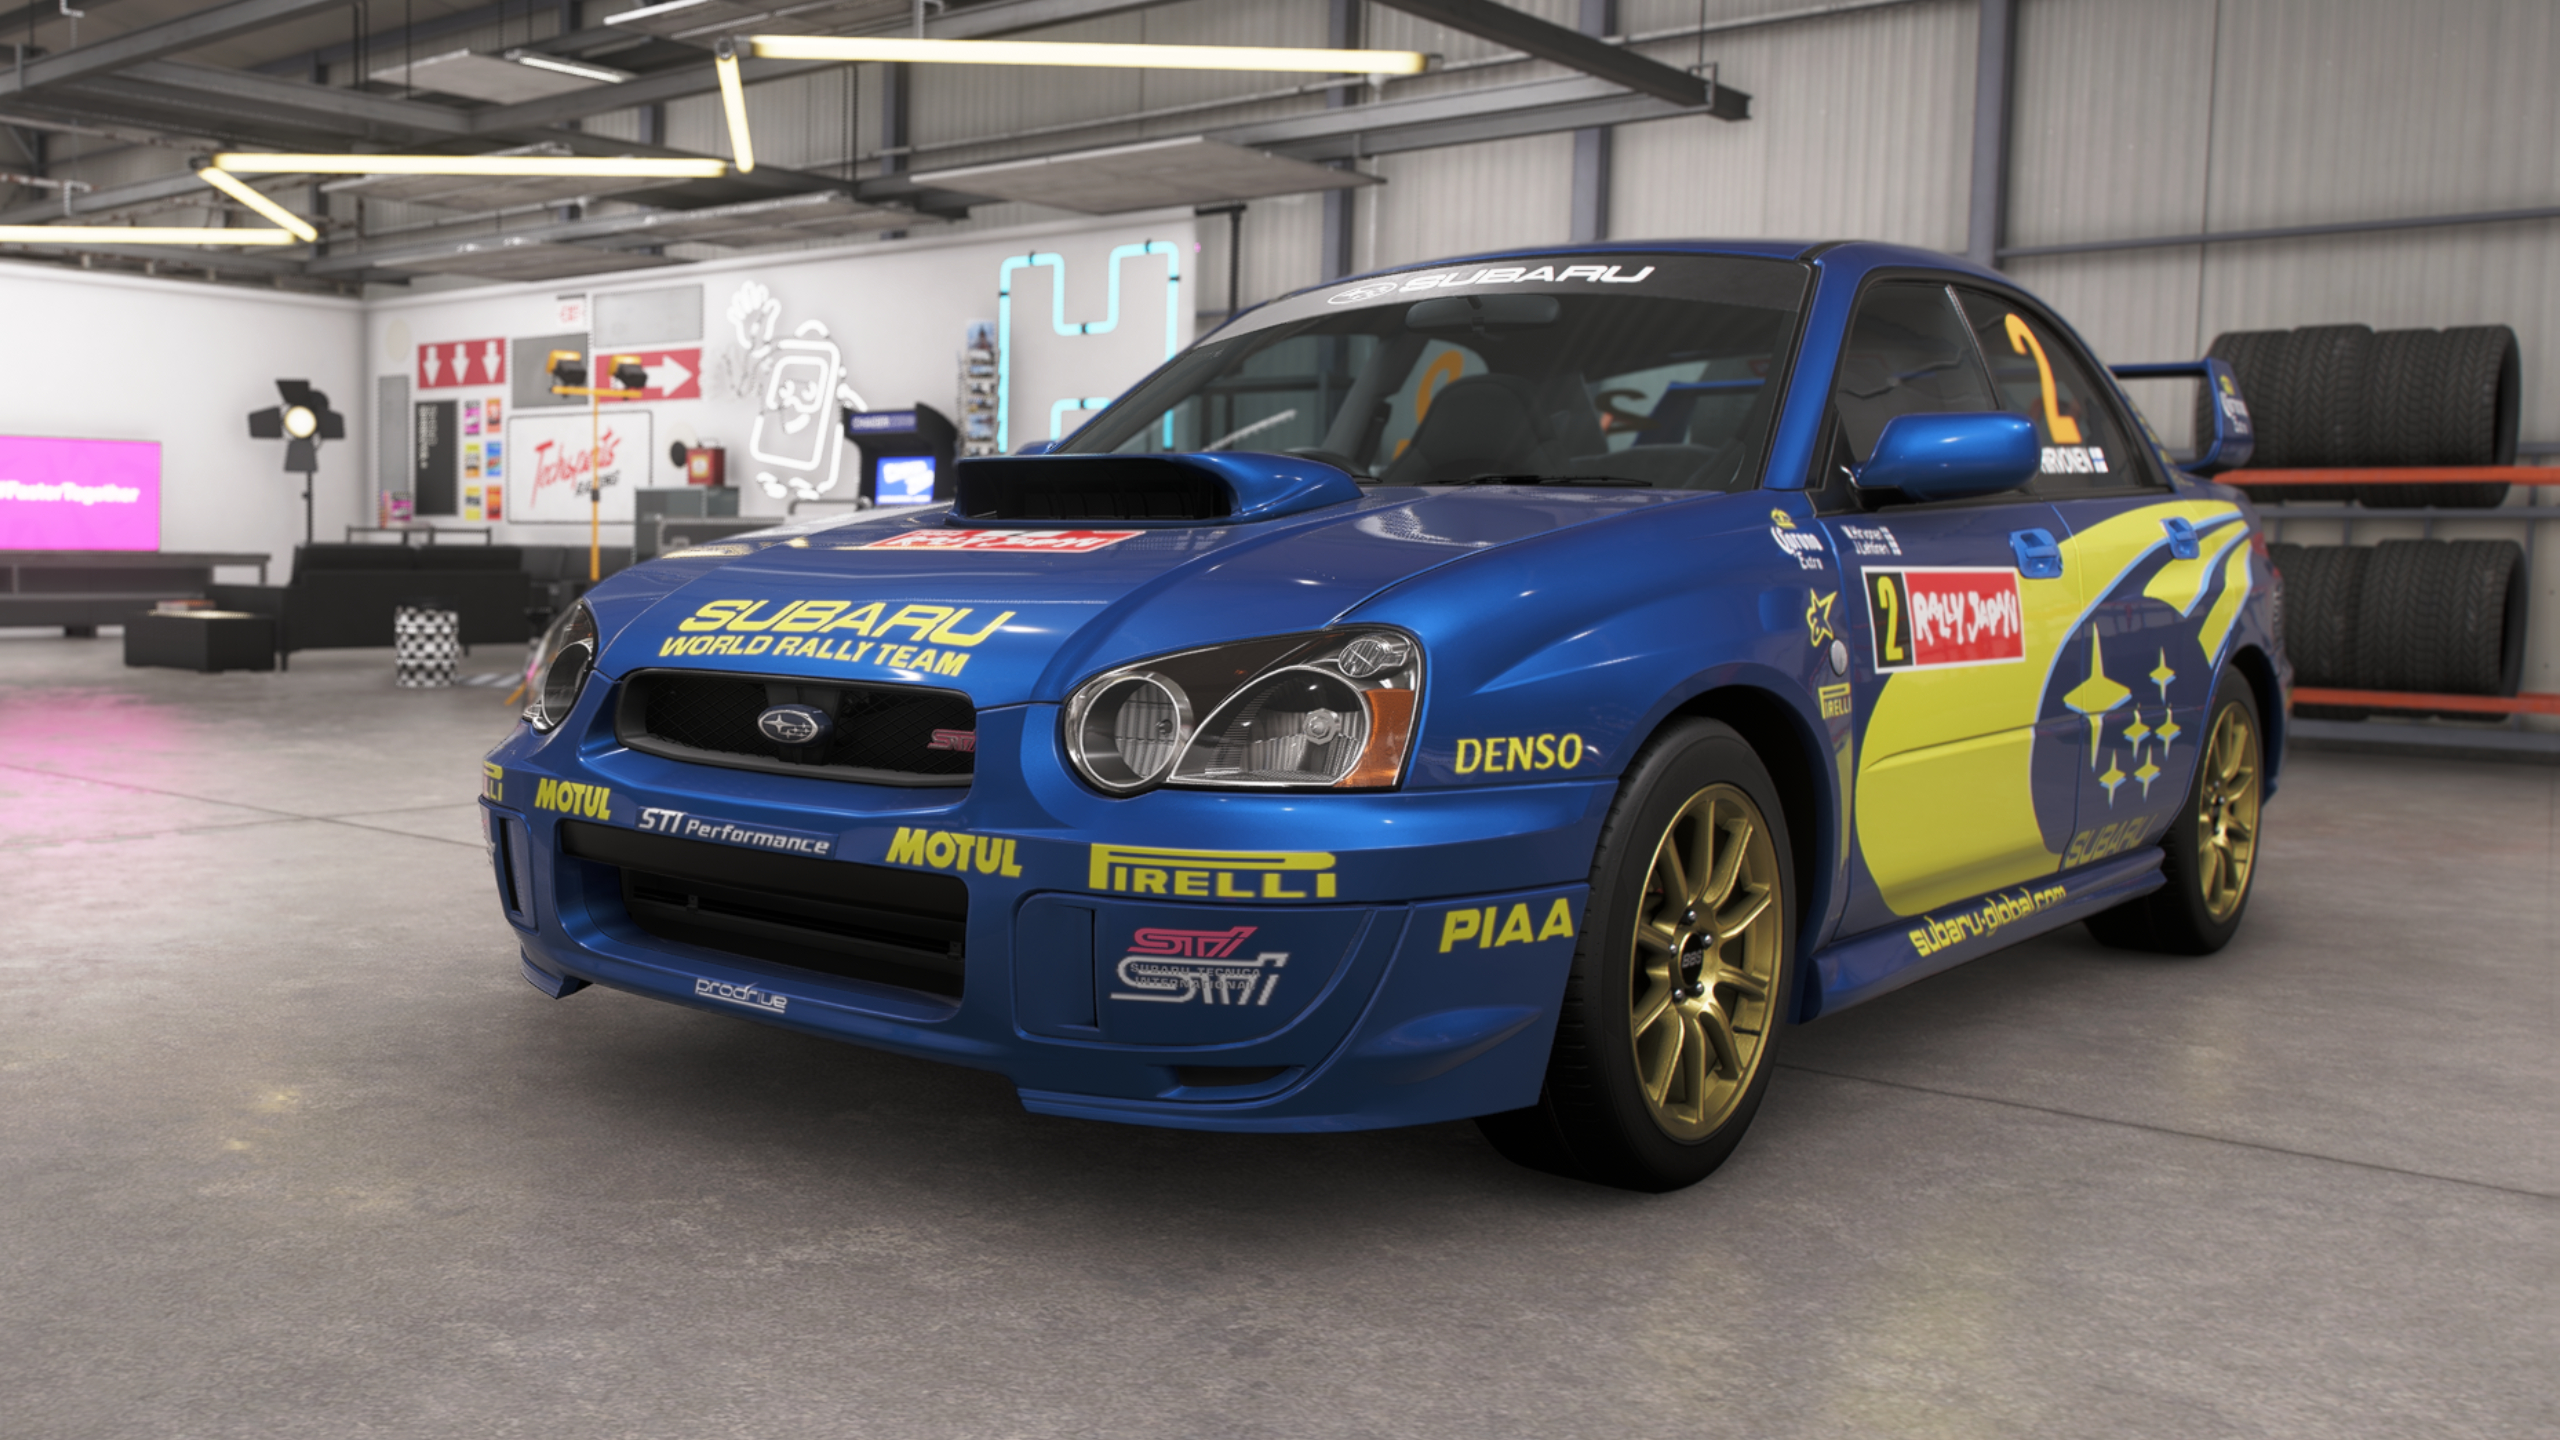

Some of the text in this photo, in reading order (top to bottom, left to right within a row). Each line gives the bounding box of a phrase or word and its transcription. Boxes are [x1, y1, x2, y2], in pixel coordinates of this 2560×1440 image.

[1399, 265, 1656, 294] SUBARU
[2005, 313, 2082, 444] 2
[678, 600, 1016, 647] SUBARU
[1877, 576, 1904, 661] 2
[658, 636, 971, 677] WORLD RALLY TEAM
[1818, 682, 1850, 720] PIRELLI
[1455, 733, 1584, 776] DENSO
[534, 777, 612, 821] MOTUL
[638, 807, 831, 855] STI Performance
[885, 827, 1023, 879] MOTUL
[2064, 813, 2159, 869] SUBARU
[1089, 843, 1337, 898] PIRELLI
[1438, 898, 1575, 954] PIAA
[1130, 962, 1262, 979] SUBARU TECNICA
[1681, 949, 1702, 969] BBS
[695, 978, 788, 1010] prodrive
